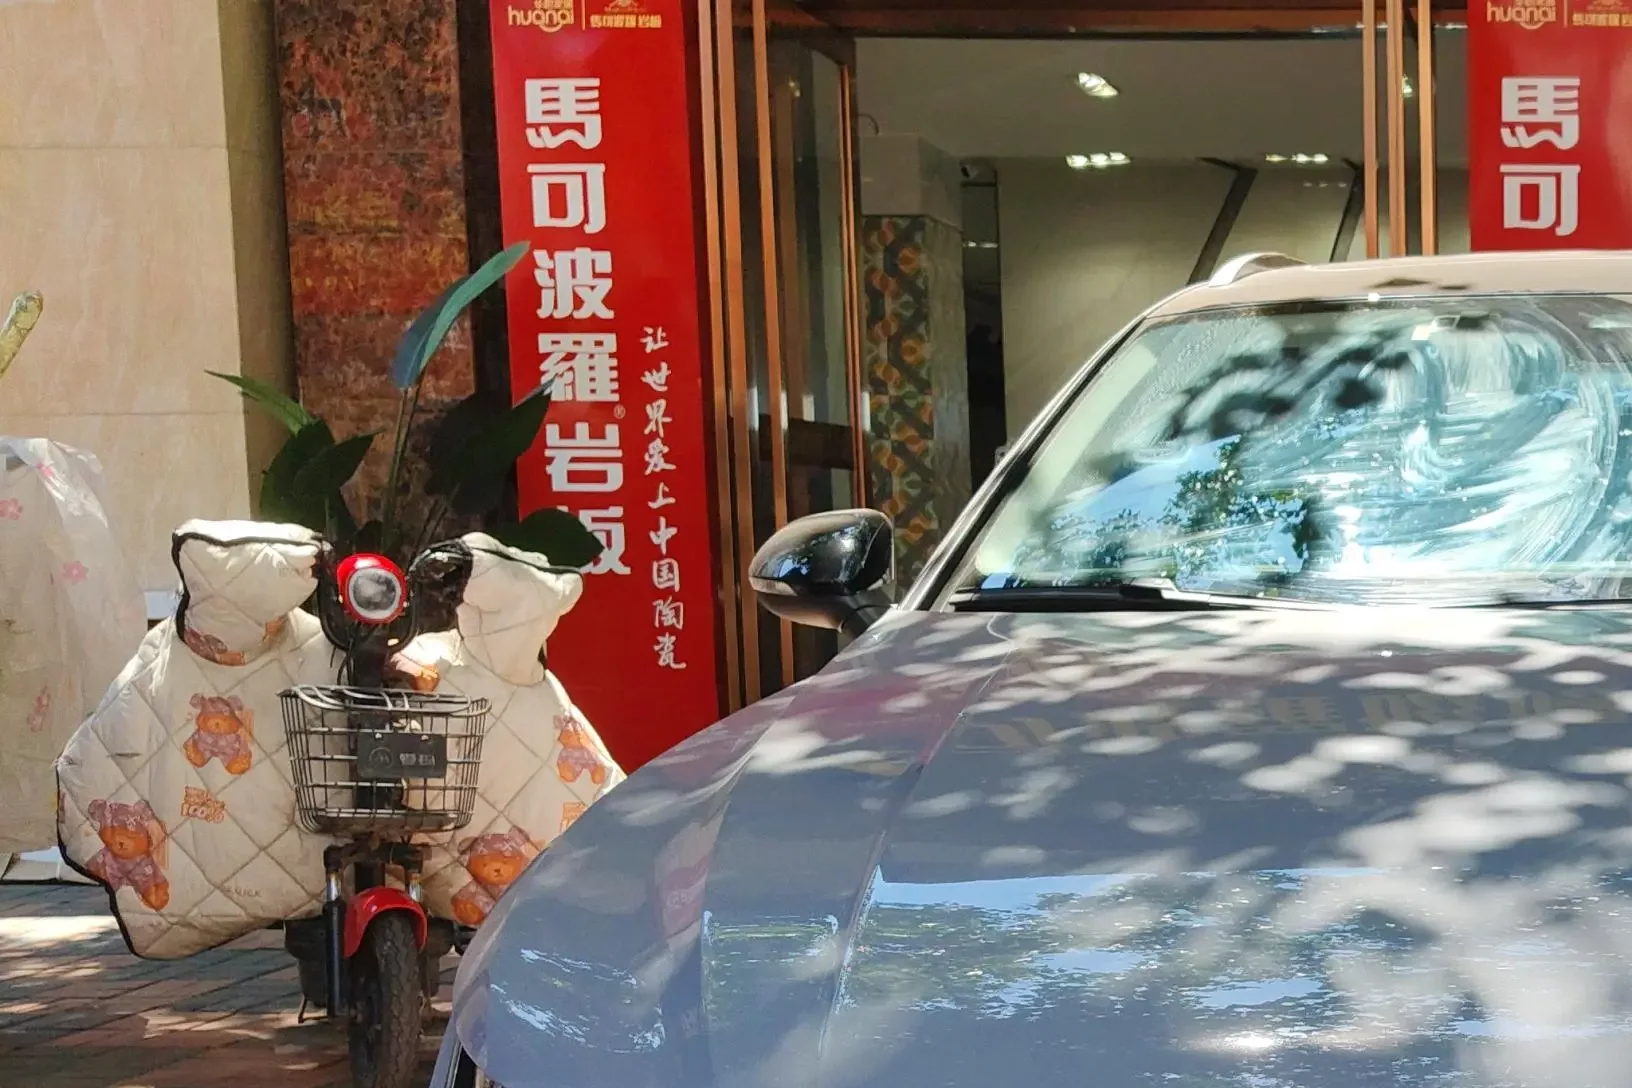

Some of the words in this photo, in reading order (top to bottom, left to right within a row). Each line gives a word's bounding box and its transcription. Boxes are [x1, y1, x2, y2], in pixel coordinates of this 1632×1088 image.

[1500, 75, 1581, 237] 馬可
[639, 326, 687, 669] 让世界爱上中国陶瓷
